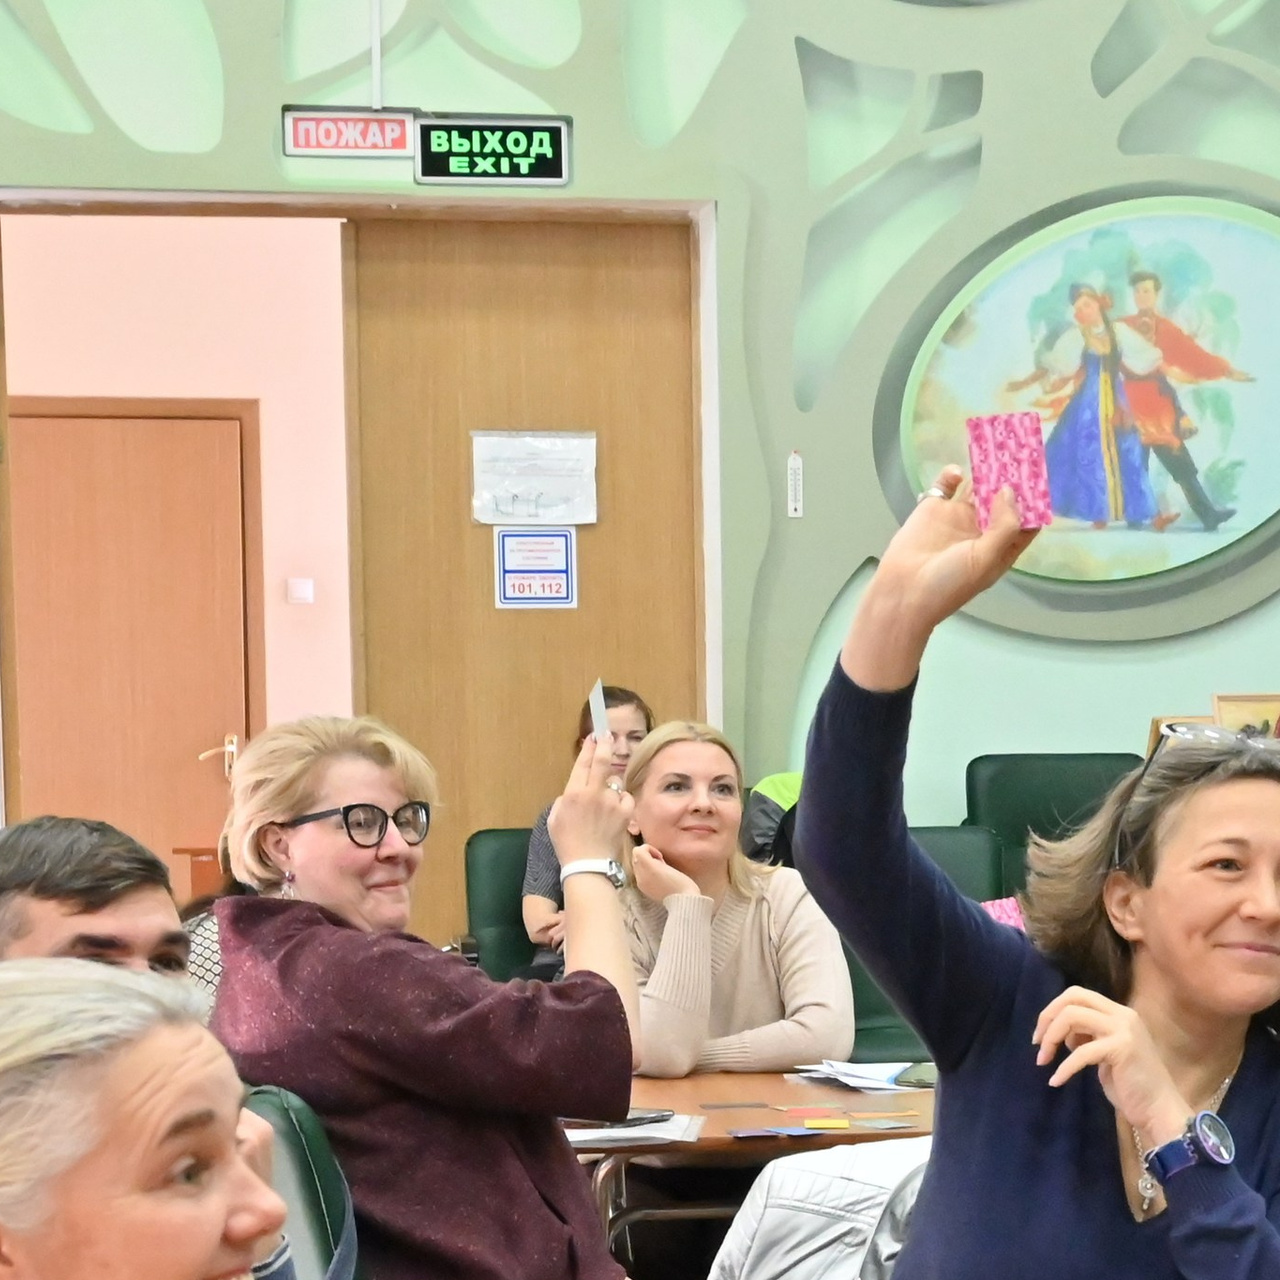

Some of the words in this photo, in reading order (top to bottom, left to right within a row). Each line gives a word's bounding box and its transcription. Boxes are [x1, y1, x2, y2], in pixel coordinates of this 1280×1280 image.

[297, 120, 401, 148] ПОЖАР
[430, 130, 553, 158] ВЫХОД
[449, 156, 535, 175] EXIT
[540, 582, 563, 594] 112
